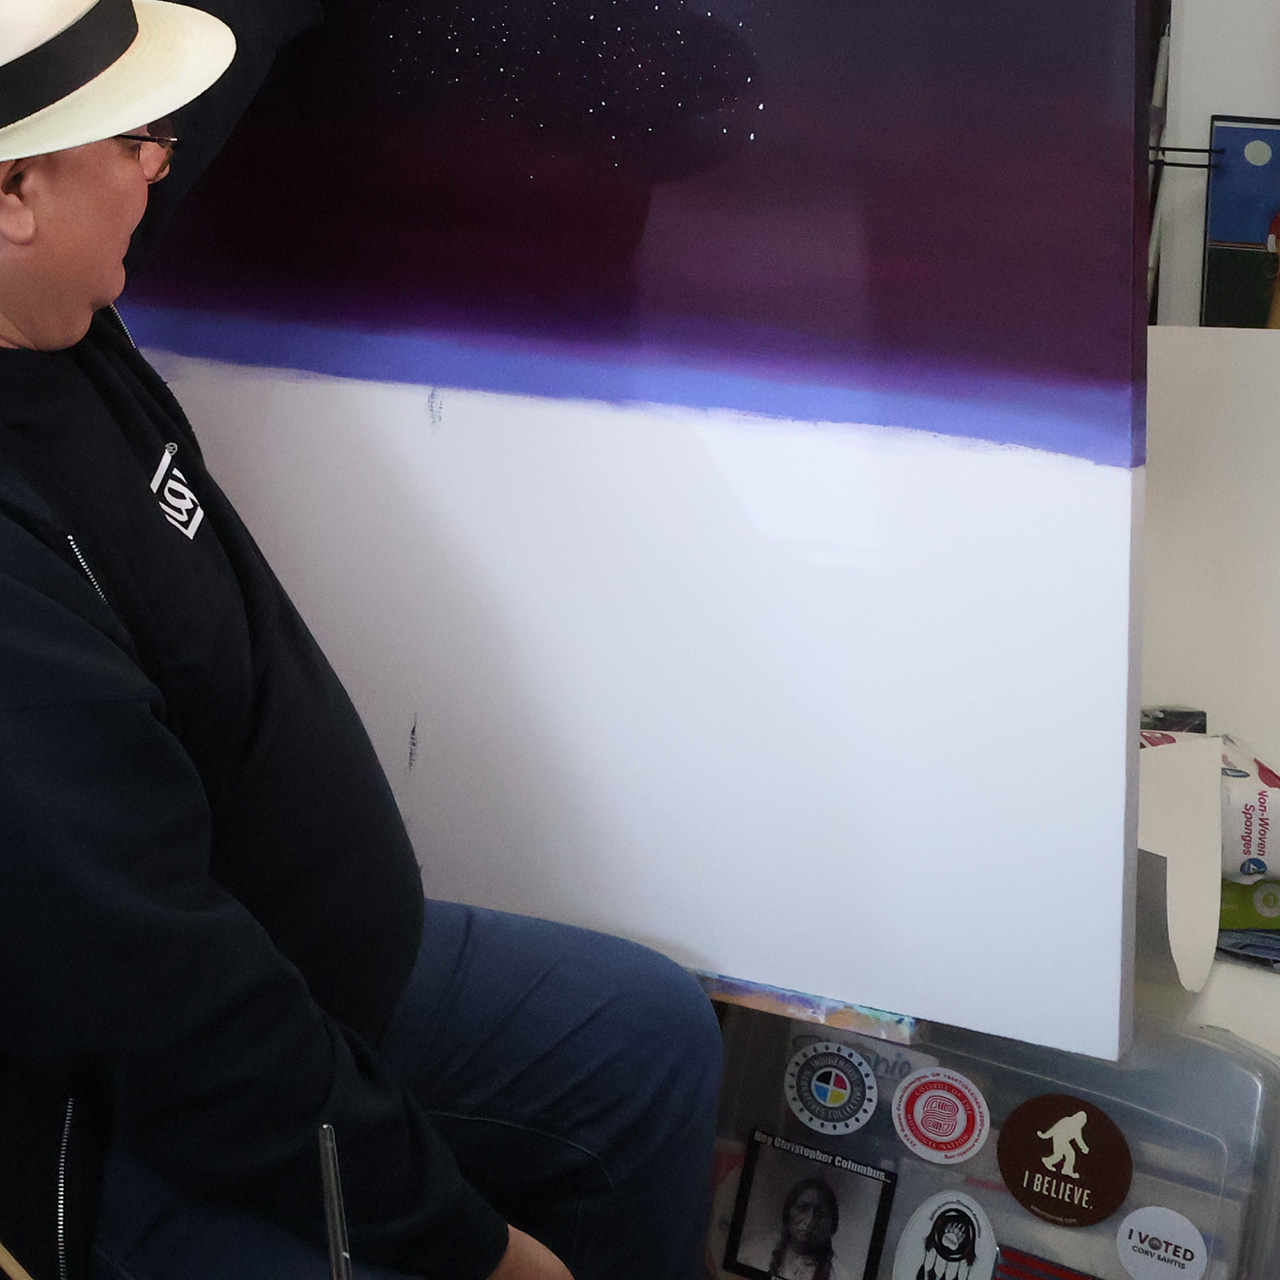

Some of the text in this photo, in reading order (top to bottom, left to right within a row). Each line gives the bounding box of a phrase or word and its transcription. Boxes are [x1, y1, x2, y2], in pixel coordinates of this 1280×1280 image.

[1241, 803, 1256, 856] Sponges
[773, 1136, 834, 1166] Christopher
[1022, 1169, 1094, 1210] I BELIEVE.
[1127, 1228, 1195, 1262] I VOTED
